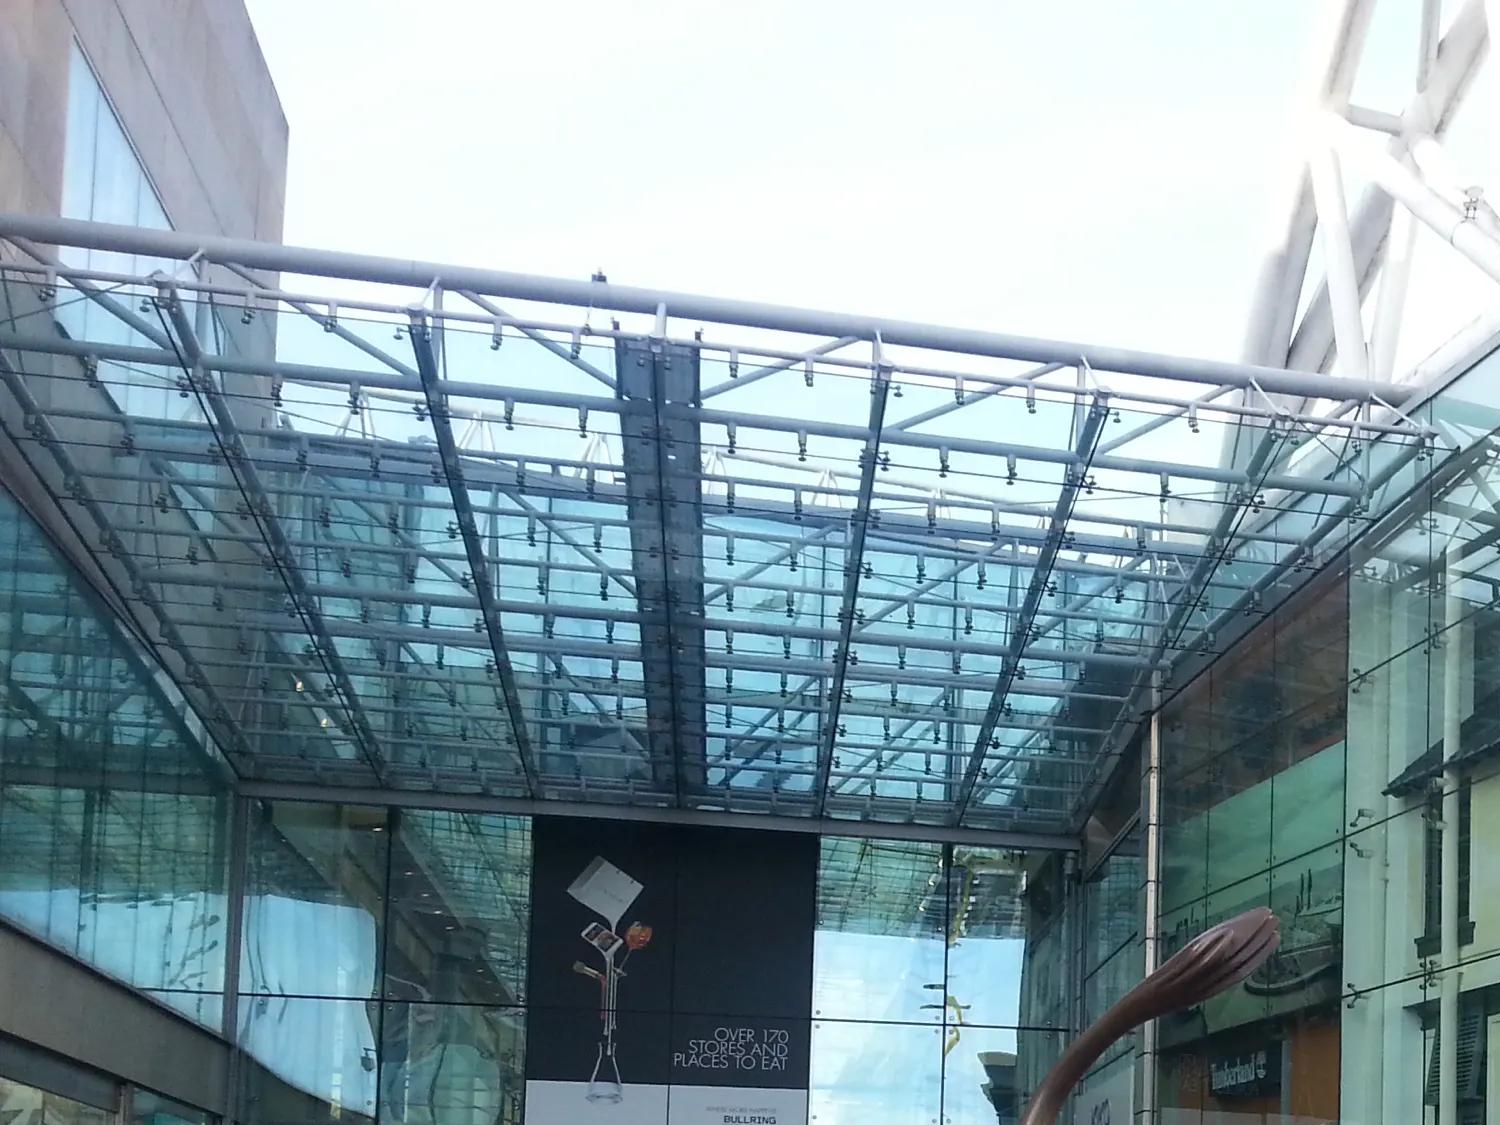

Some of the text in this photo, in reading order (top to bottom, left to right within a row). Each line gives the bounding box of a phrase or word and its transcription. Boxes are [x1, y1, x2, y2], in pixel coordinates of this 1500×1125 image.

[714, 1027, 789, 1044] OVER 170
[688, 1039, 788, 1057] STORES AND
[673, 1052, 788, 1071] PLACES TO EAT
[723, 1115, 777, 1125] BULLRING
